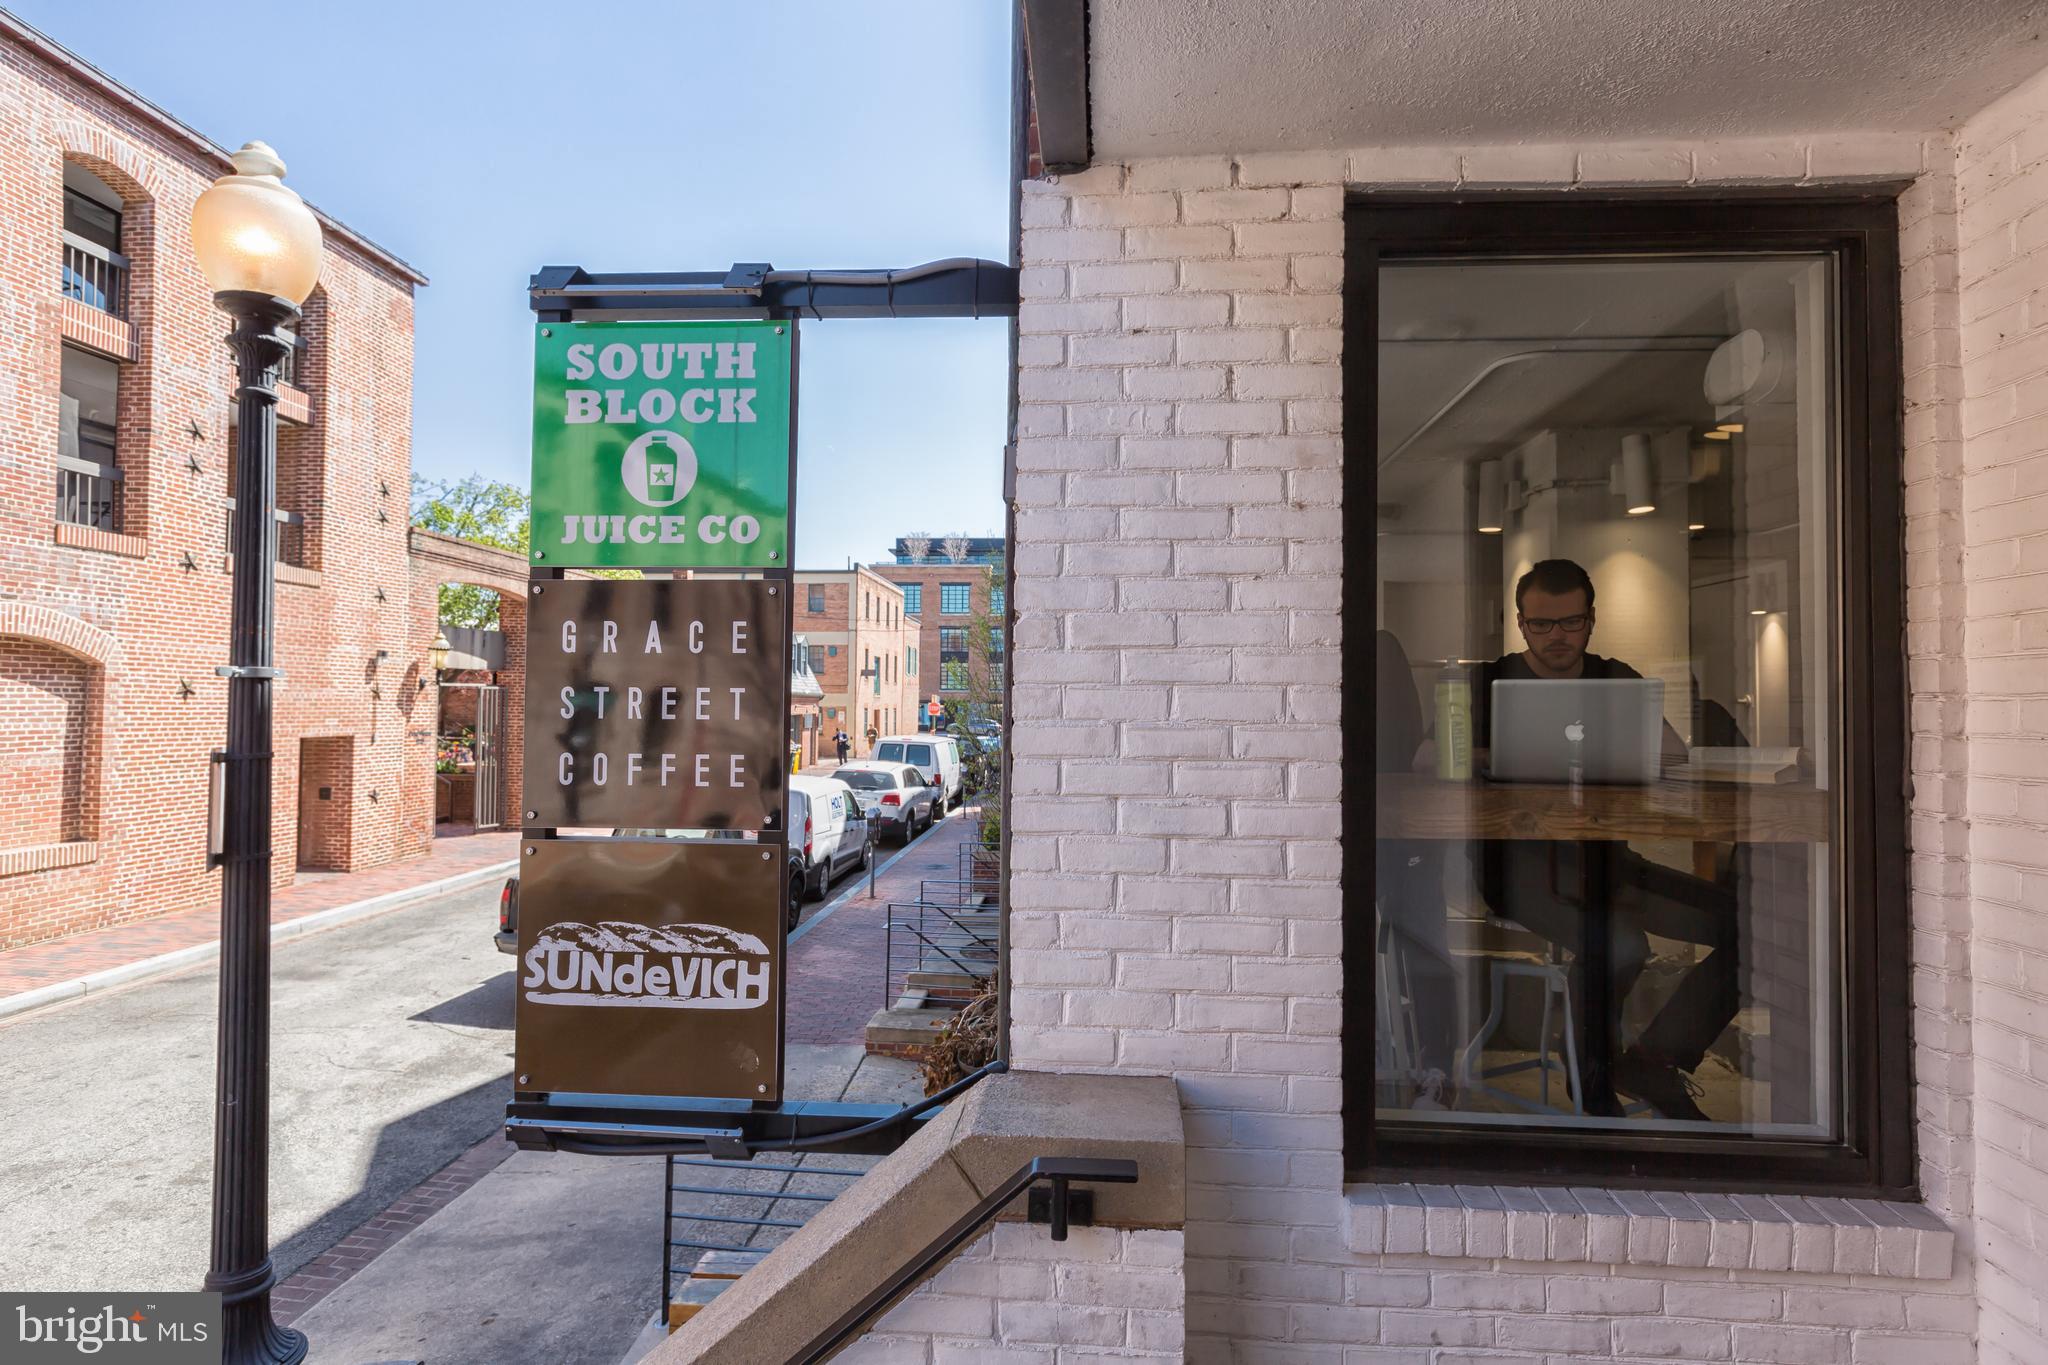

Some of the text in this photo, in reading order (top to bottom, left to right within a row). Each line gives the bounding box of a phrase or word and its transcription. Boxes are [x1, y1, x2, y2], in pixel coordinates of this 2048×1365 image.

[566, 342, 757, 381] SOUTH
[564, 387, 757, 424] BLOCK
[560, 515, 760, 544] JUICE CO
[561, 620, 747, 654] GRACE
[560, 686, 746, 721] STREET
[558, 752, 745, 788] COFFEE
[523, 949, 770, 1000] SUNdeVICH
